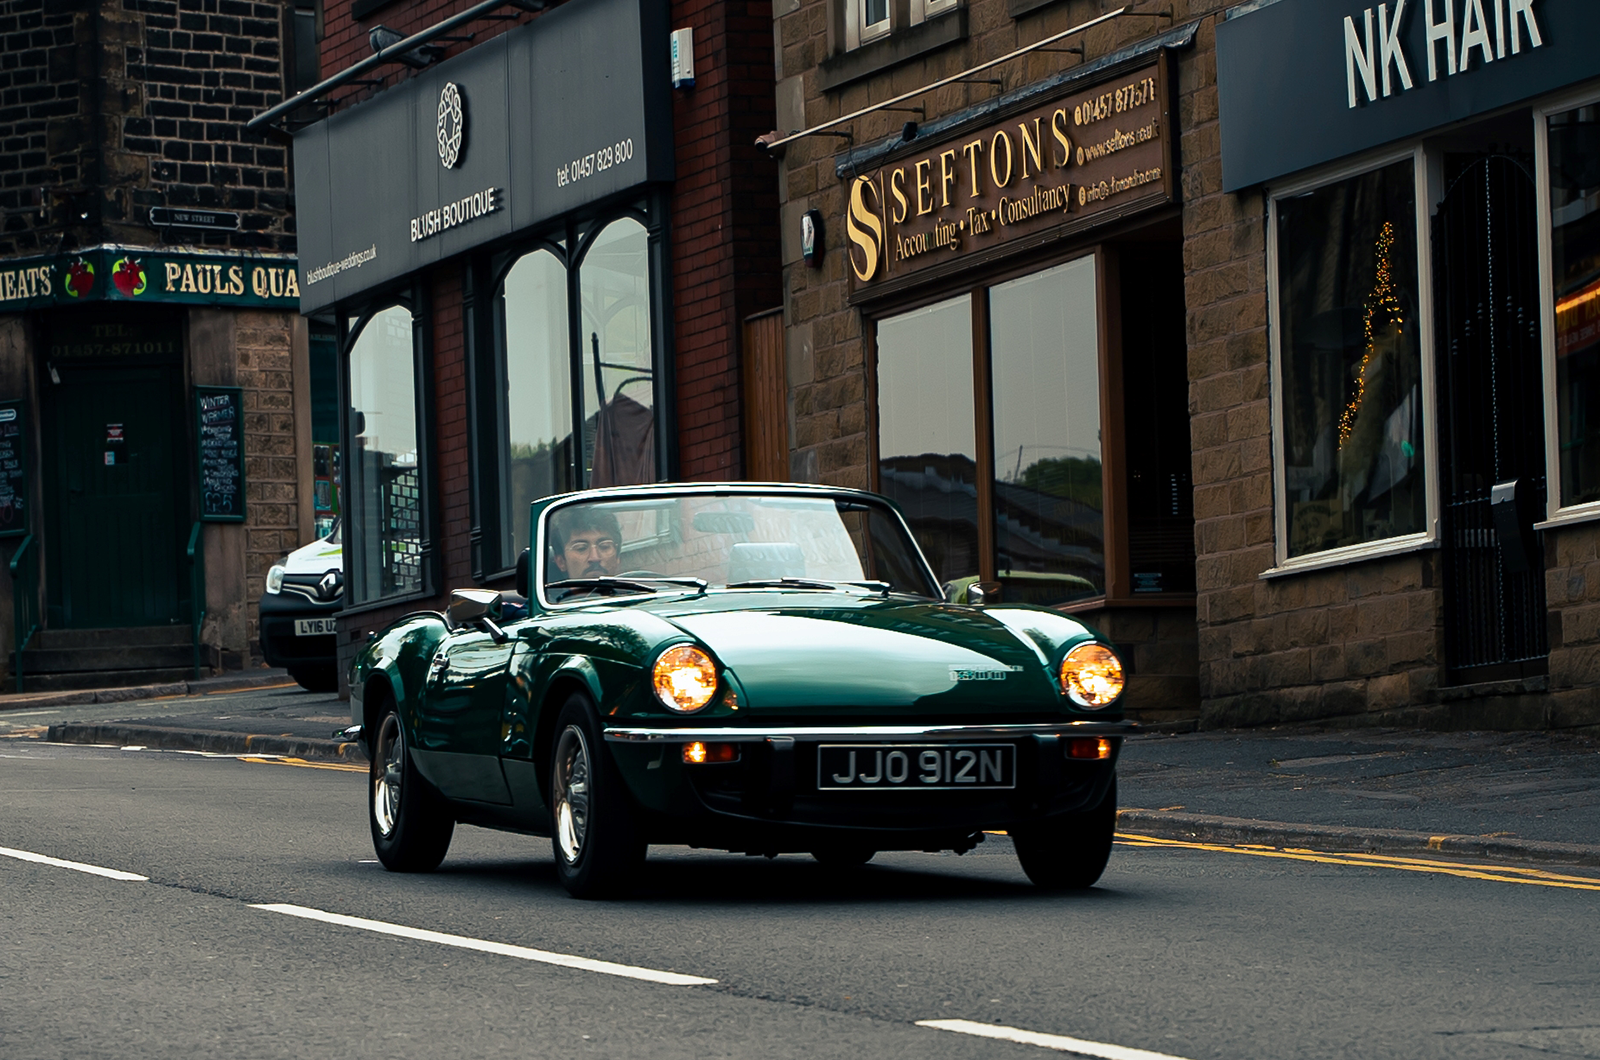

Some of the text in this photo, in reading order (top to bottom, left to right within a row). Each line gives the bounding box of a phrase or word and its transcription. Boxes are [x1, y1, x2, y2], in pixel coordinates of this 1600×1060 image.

[1343, 0, 1543, 109] NK HAIR
[1082, 77, 1155, 125] 01457 877571
[571, 153, 595, 182] 01457
[597, 146, 613, 172] 829
[615, 138, 633, 165] 800
[890, 107, 1071, 226] SEFTONS
[174, 213, 216, 224] NEW STREET
[410, 186, 495, 243] BLUSH BOUTIQUE
[895, 183, 1070, 261] Accounting Tax Consultancy
[164, 262, 300, 299] PAULS QUA
[51, 341, 175, 357] 01457-871011
[200, 394, 231, 409] WINTER
[300, 620, 324, 634] LY16
[832, 749, 1002, 784] JJO 912N
